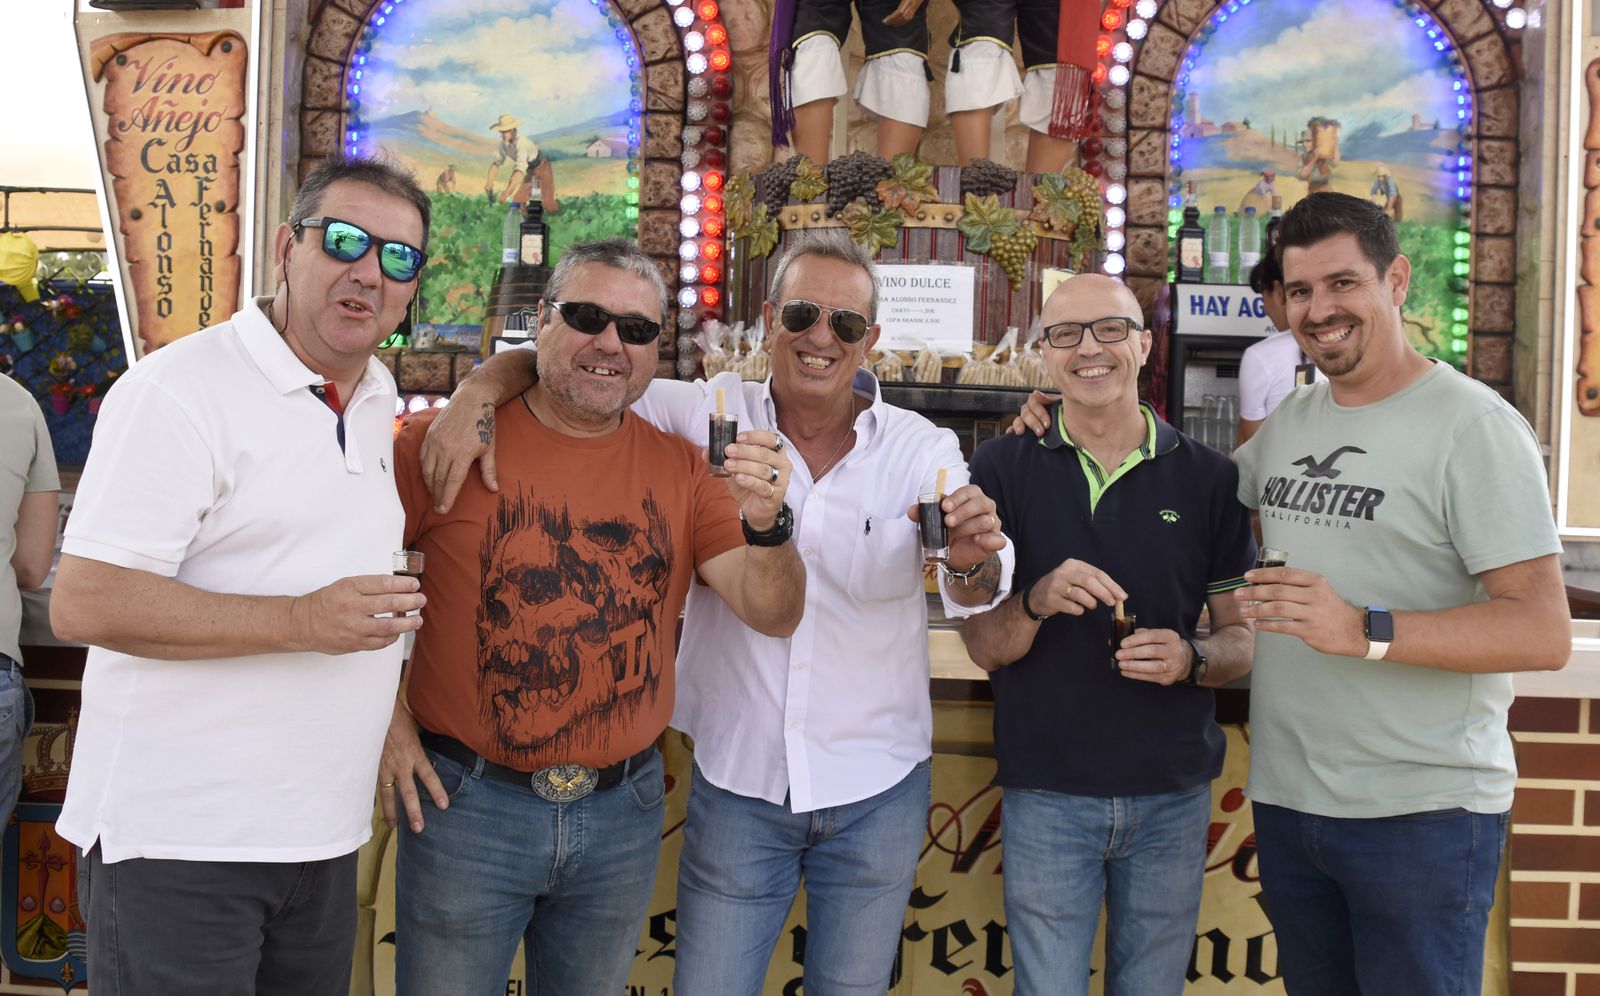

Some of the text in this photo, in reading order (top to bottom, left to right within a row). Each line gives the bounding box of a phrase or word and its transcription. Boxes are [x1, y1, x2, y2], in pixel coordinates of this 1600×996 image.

[127, 54, 222, 97] Vino
[118, 95, 228, 152] Añejo
[140, 138, 219, 176] Casa
[147, 178, 177, 320] Alonso
[188, 175, 218, 331] Fernande
[910, 277, 951, 289] DULCE
[1190, 295, 1268, 319] HAY AG
[1259, 476, 1386, 522] HOLLISTER
[1264, 509, 1352, 531] CALIFORNIA
